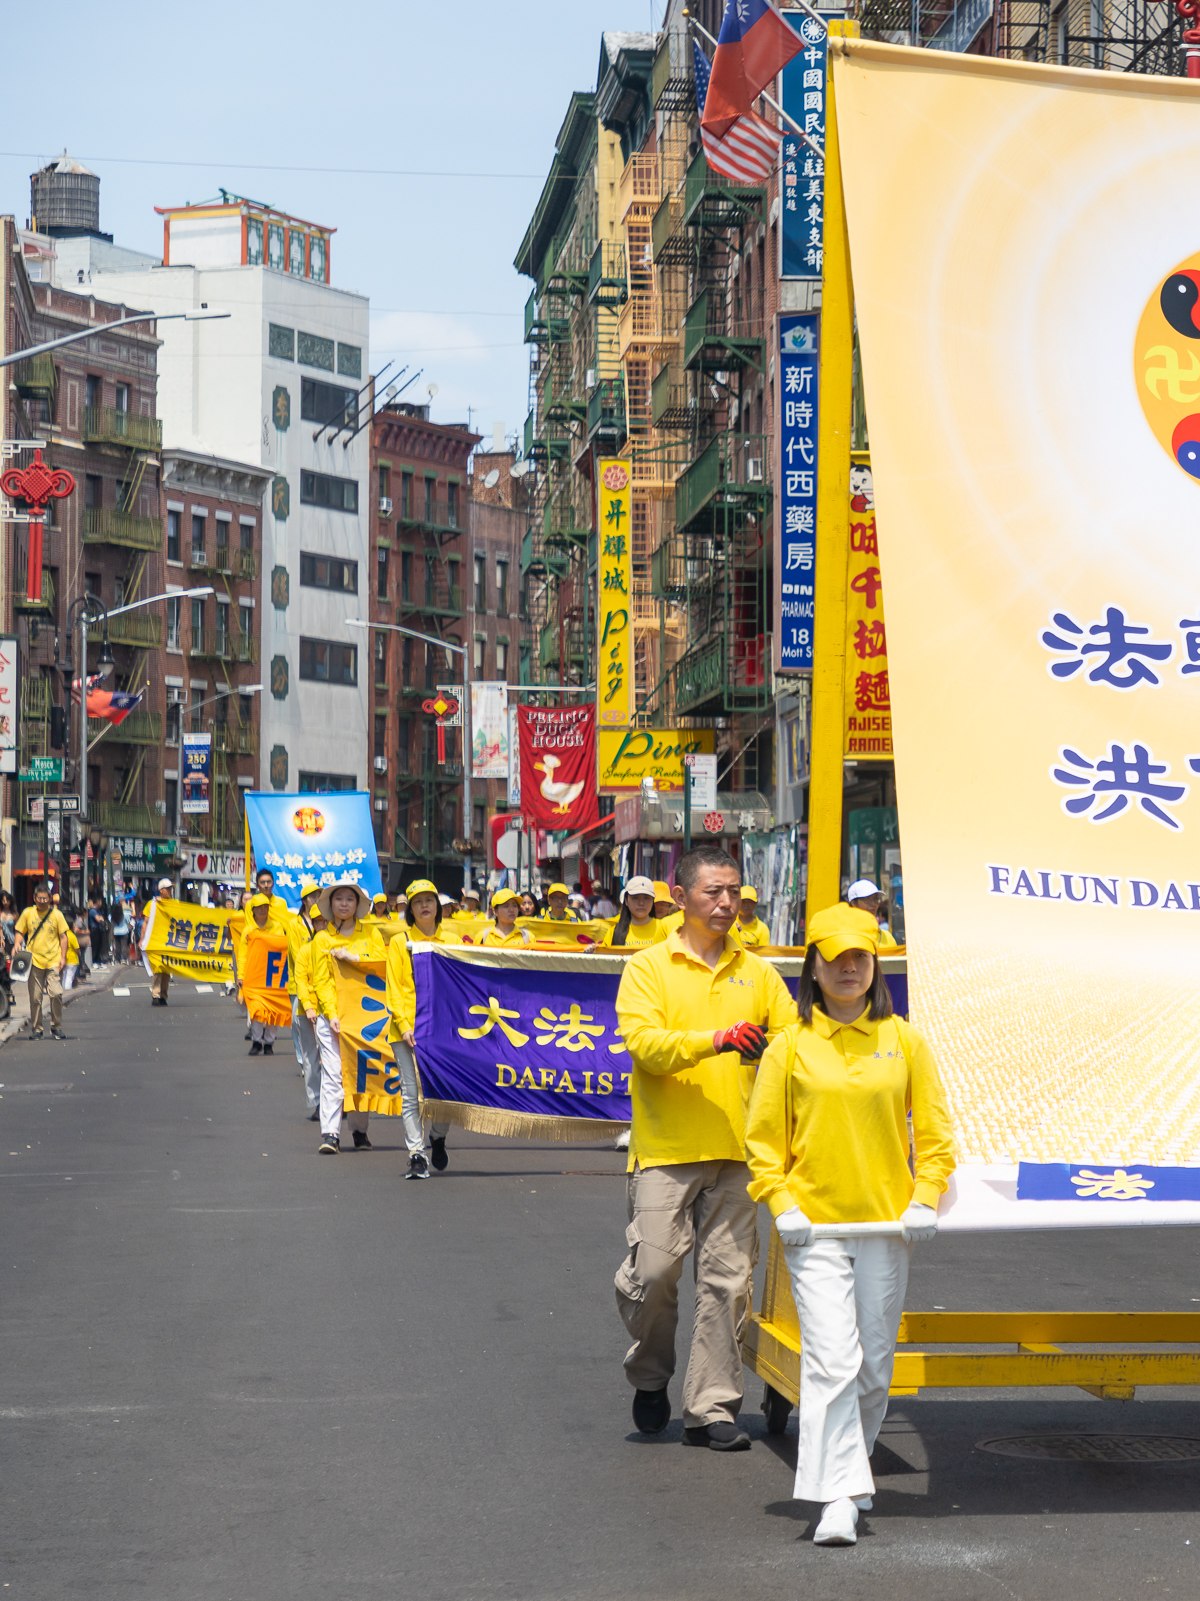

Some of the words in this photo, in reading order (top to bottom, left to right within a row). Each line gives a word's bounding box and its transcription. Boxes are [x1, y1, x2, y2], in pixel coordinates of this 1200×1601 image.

[785, 365, 815, 571] 新時代西藥房
[782, 584, 813, 596] DIN
[781, 602, 815, 618] PHARMAC
[791, 628, 810, 645] 18
[602, 608, 628, 704] Ping
[781, 647, 802, 658] Mott
[526, 709, 589, 724] PEKING
[535, 723, 580, 736] DUCK
[532, 734, 584, 748] HOUSE
[35, 758, 54, 769] Mosco
[602, 766, 646, 783] Seafood
[124, 859, 145, 873] Health
[146, 860, 156, 873] Inc
[190, 853, 197, 873] I
[209, 853, 230, 875] NY
[264, 848, 368, 870] 法輪大法好
[988, 865, 1120, 905] FALUN
[496, 1063, 576, 1094] DAFA
[582, 1071, 613, 1096] IS
